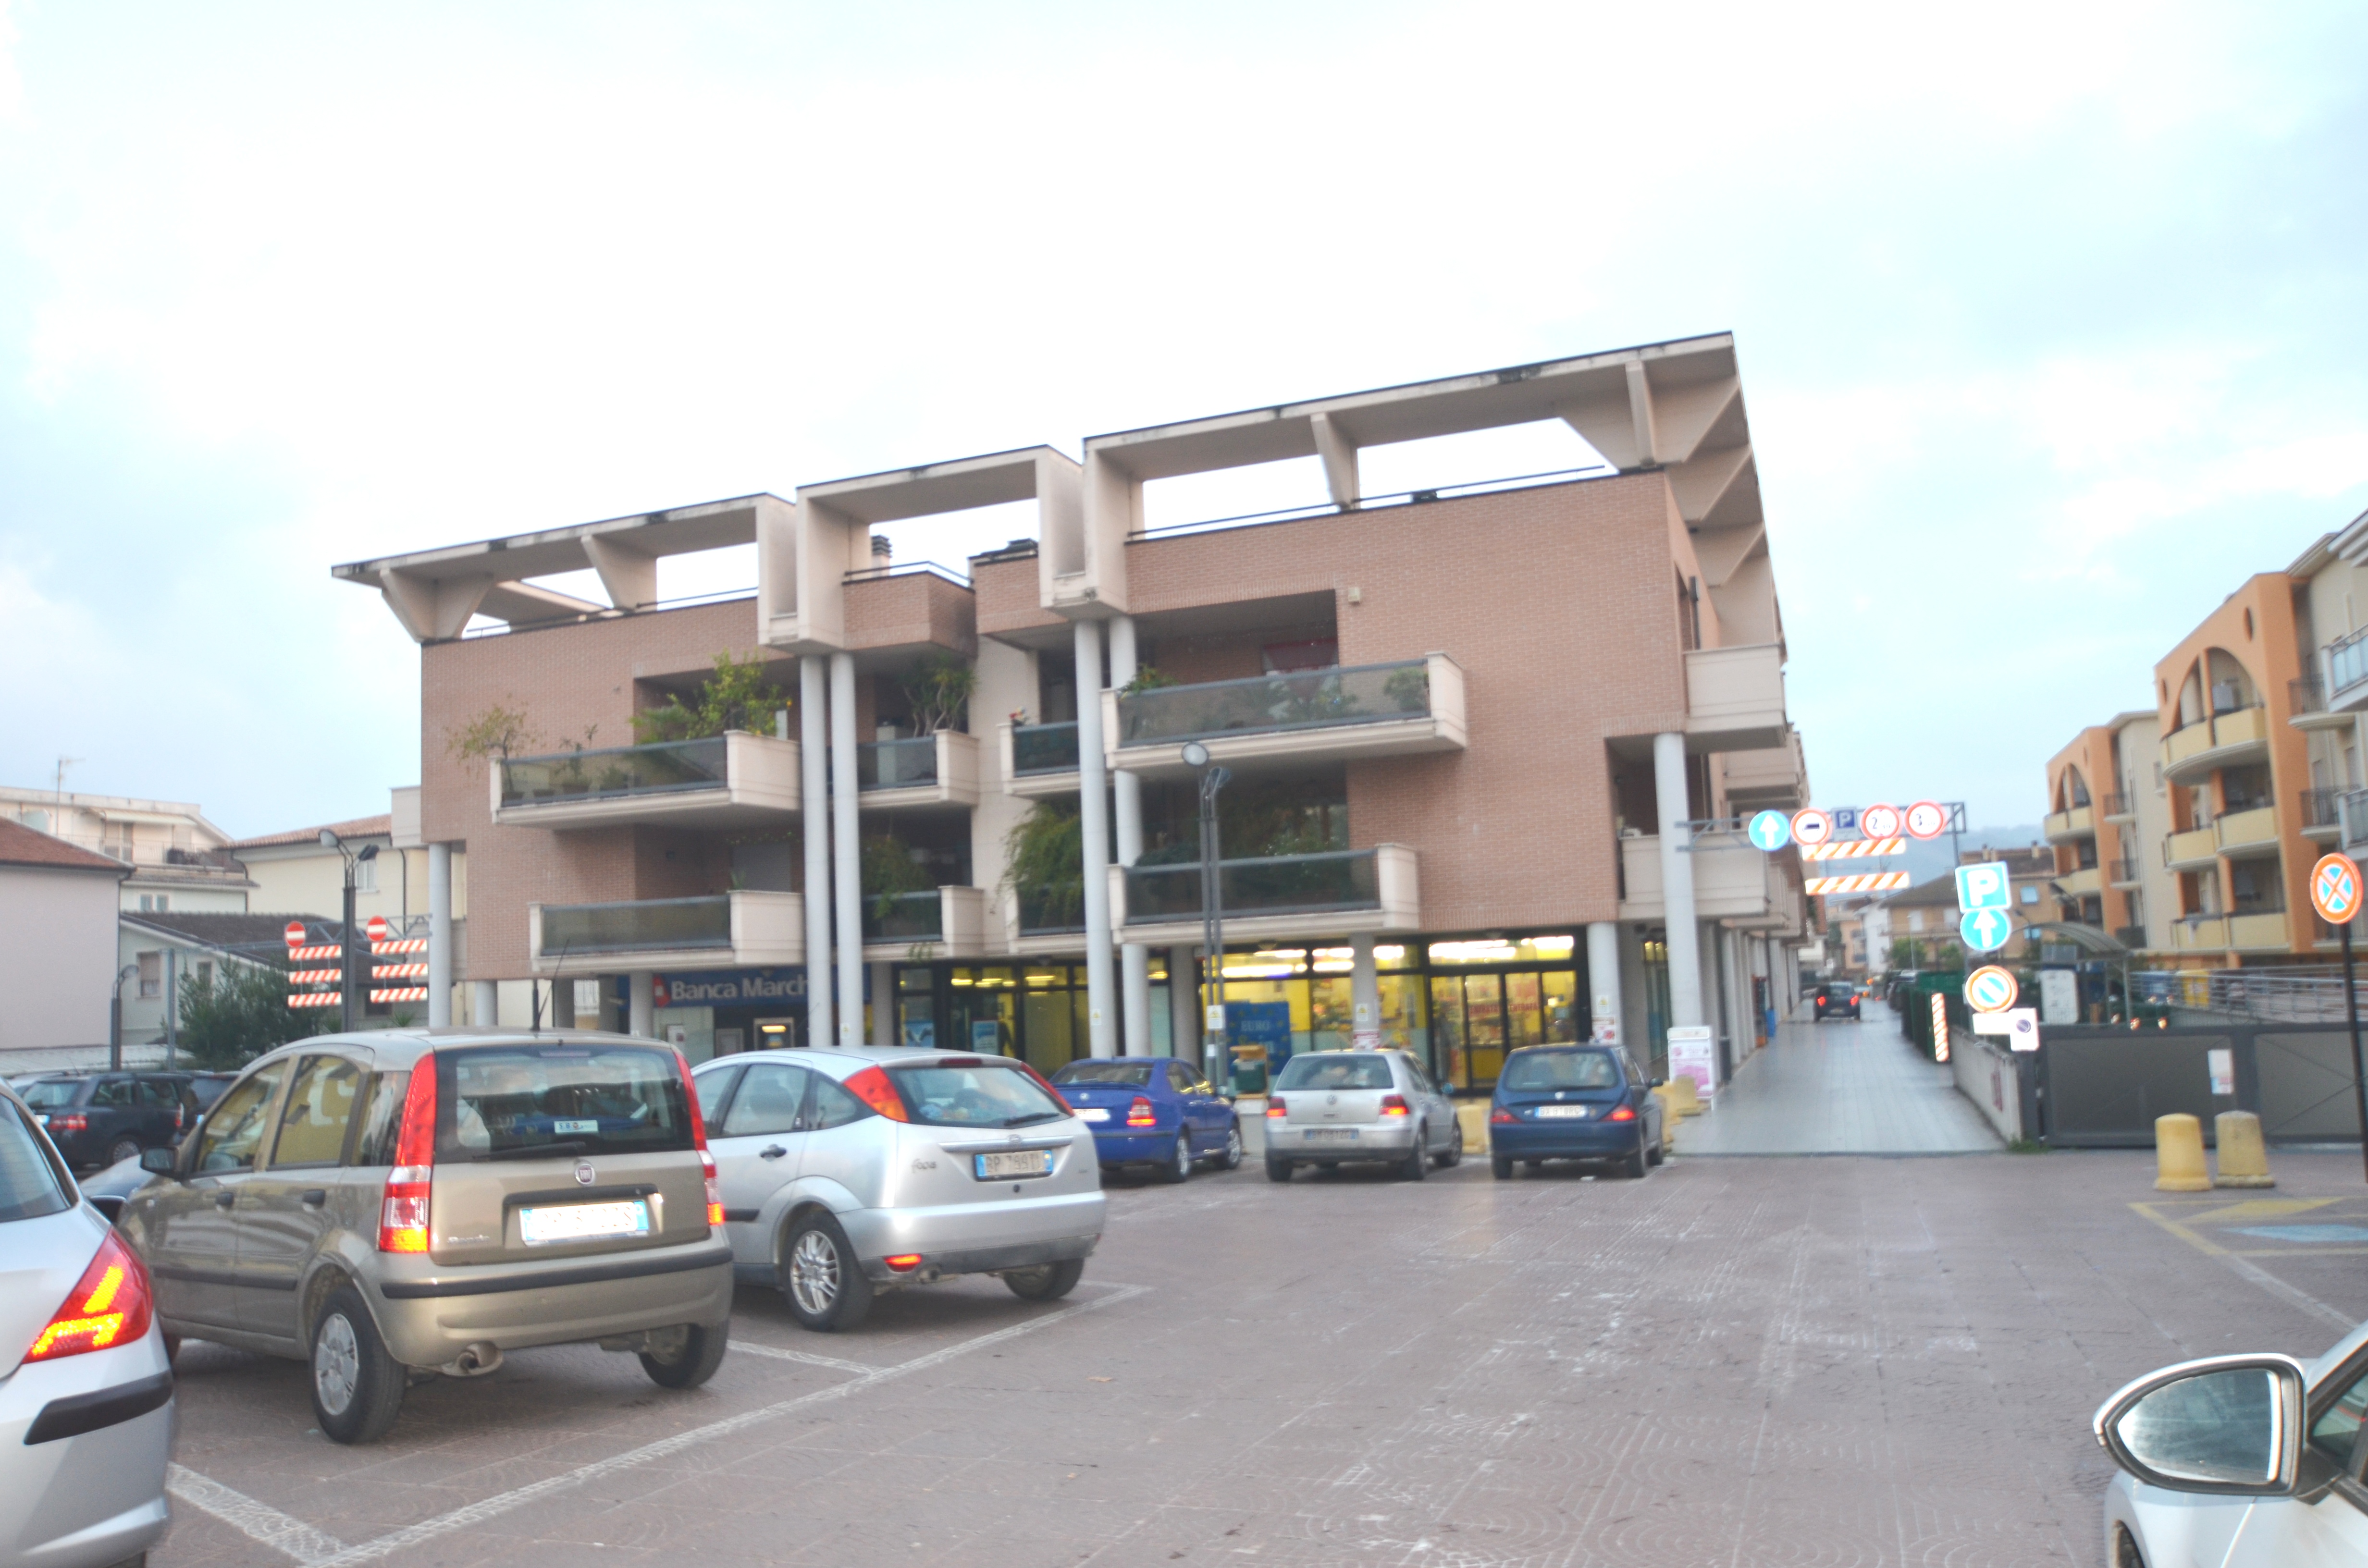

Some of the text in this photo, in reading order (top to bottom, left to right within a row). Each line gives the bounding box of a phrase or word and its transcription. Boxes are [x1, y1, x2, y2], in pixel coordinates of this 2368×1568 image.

[1839, 812, 1851, 827] P
[1967, 869, 1999, 906] P
[672, 973, 808, 1000] Banca March
